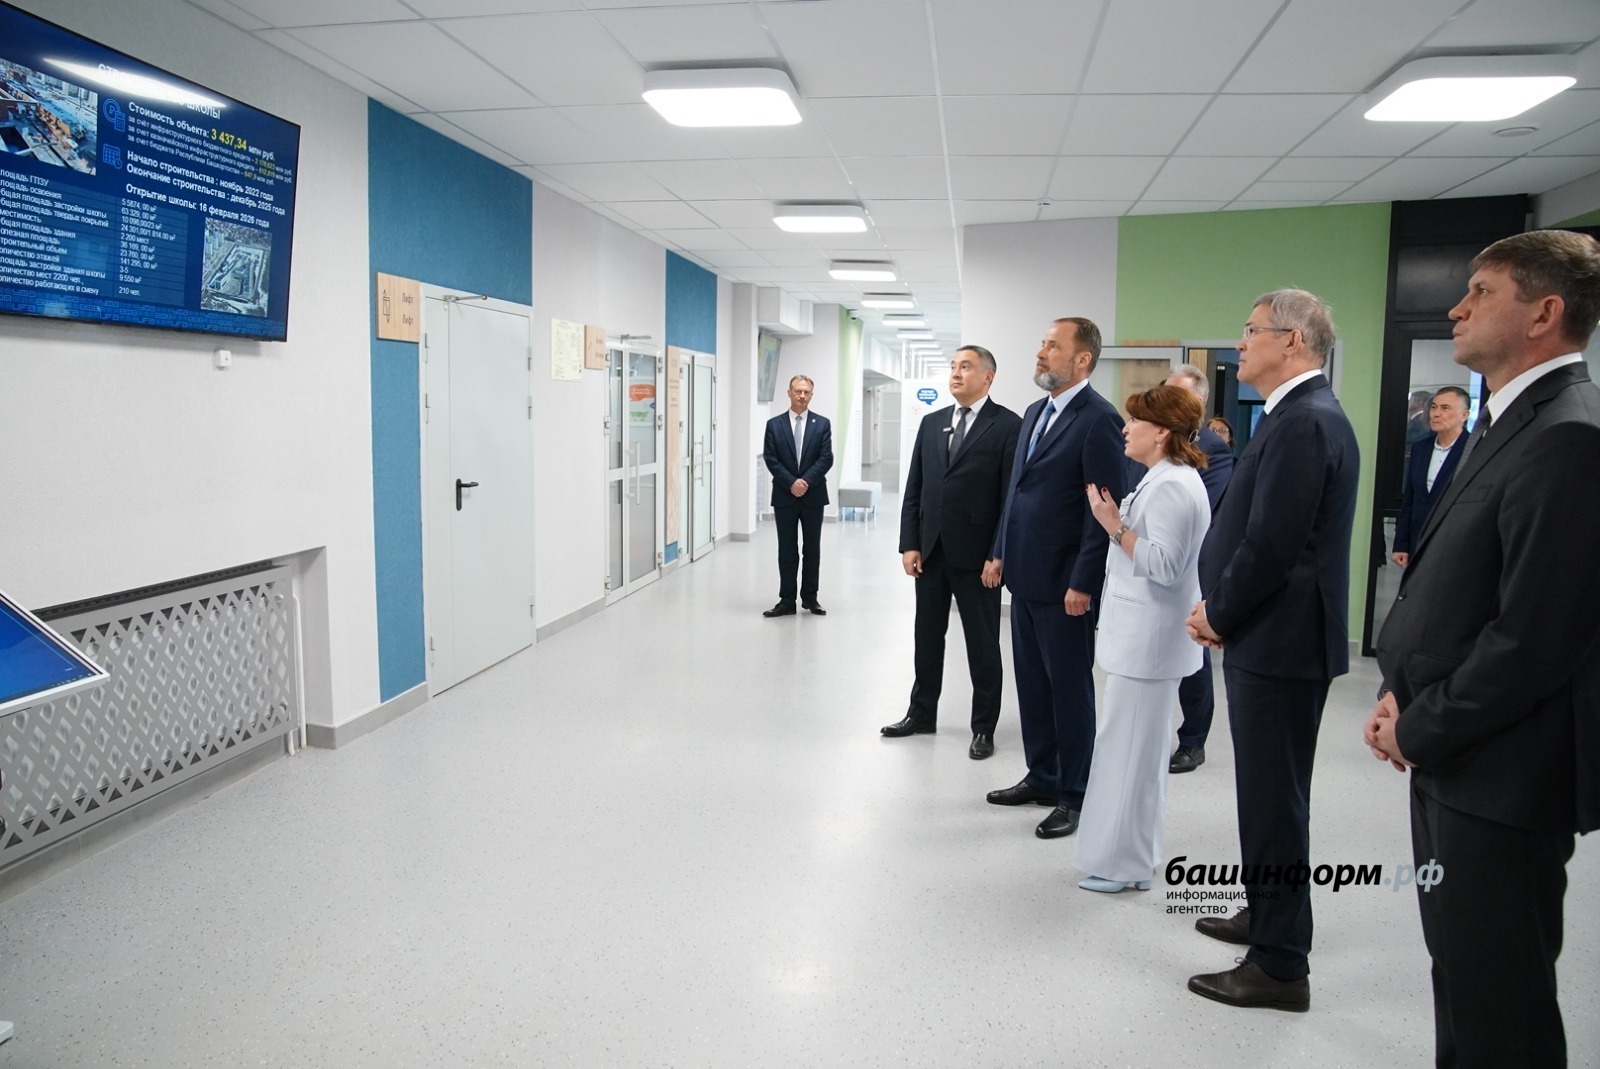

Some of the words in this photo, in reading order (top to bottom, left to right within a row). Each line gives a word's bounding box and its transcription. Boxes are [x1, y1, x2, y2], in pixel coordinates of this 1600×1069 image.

[128, 101, 175, 126] Стоимость
[176, 120, 210, 138] объекта:
[211, 128, 217, 140] 3
[218, 131, 247, 151] 437,34
[248, 145, 262, 157] млн
[262, 150, 275, 162] руб.
[0, 169, 29, 182] лощадь
[127, 150, 158, 168] Начало
[159, 162, 215, 184] строительства
[220, 179, 244, 193] ноябрь
[245, 186, 260, 197] 2022
[260, 191, 274, 201] года
[0, 179, 29, 192] лощадь
[30, 186, 62, 199] освоения
[127, 163, 171, 184] Окончание
[172, 178, 226, 199] строительства
[230, 195, 257, 208] декабрь
[272, 206, 286, 216] года
[0, 188, 20, 201] бщая
[22, 194, 53, 207] площадь
[53, 201, 85, 214] застройки
[86, 208, 107, 219] школы
[0, 197, 20, 210] бщая
[22, 203, 53, 216] площадь
[54, 210, 80, 222] твердых
[81, 216, 109, 228] покрытий
[126, 183, 167, 202] Открытие
[168, 196, 197, 210] школы:
[199, 202, 207, 212] 16
[208, 205, 239, 220] февраля
[240, 213, 255, 224] 2026
[255, 219, 270, 228] года
[0, 208, 42, 223] местимость
[0, 217, 20, 230] бщая
[22, 222, 53, 235] площадь
[53, 228, 76, 239] здания
[0, 227, 29, 239] олезная
[30, 233, 60, 245] площадь
[0, 237, 45, 251] троительный
[46, 244, 67, 255] объем
[0, 247, 35, 258] оличество
[36, 253, 60, 263] этажей
[0, 256, 28, 267] лощадь
[29, 261, 62, 272] застройки
[63, 266, 85, 276] здания
[85, 270, 106, 279] школы
[0, 265, 35, 276] оличество
[36, 271, 52, 279] мест
[53, 272, 69, 282] 2200
[0, 275, 34, 286] оличество
[81, 286, 100, 296] смену
